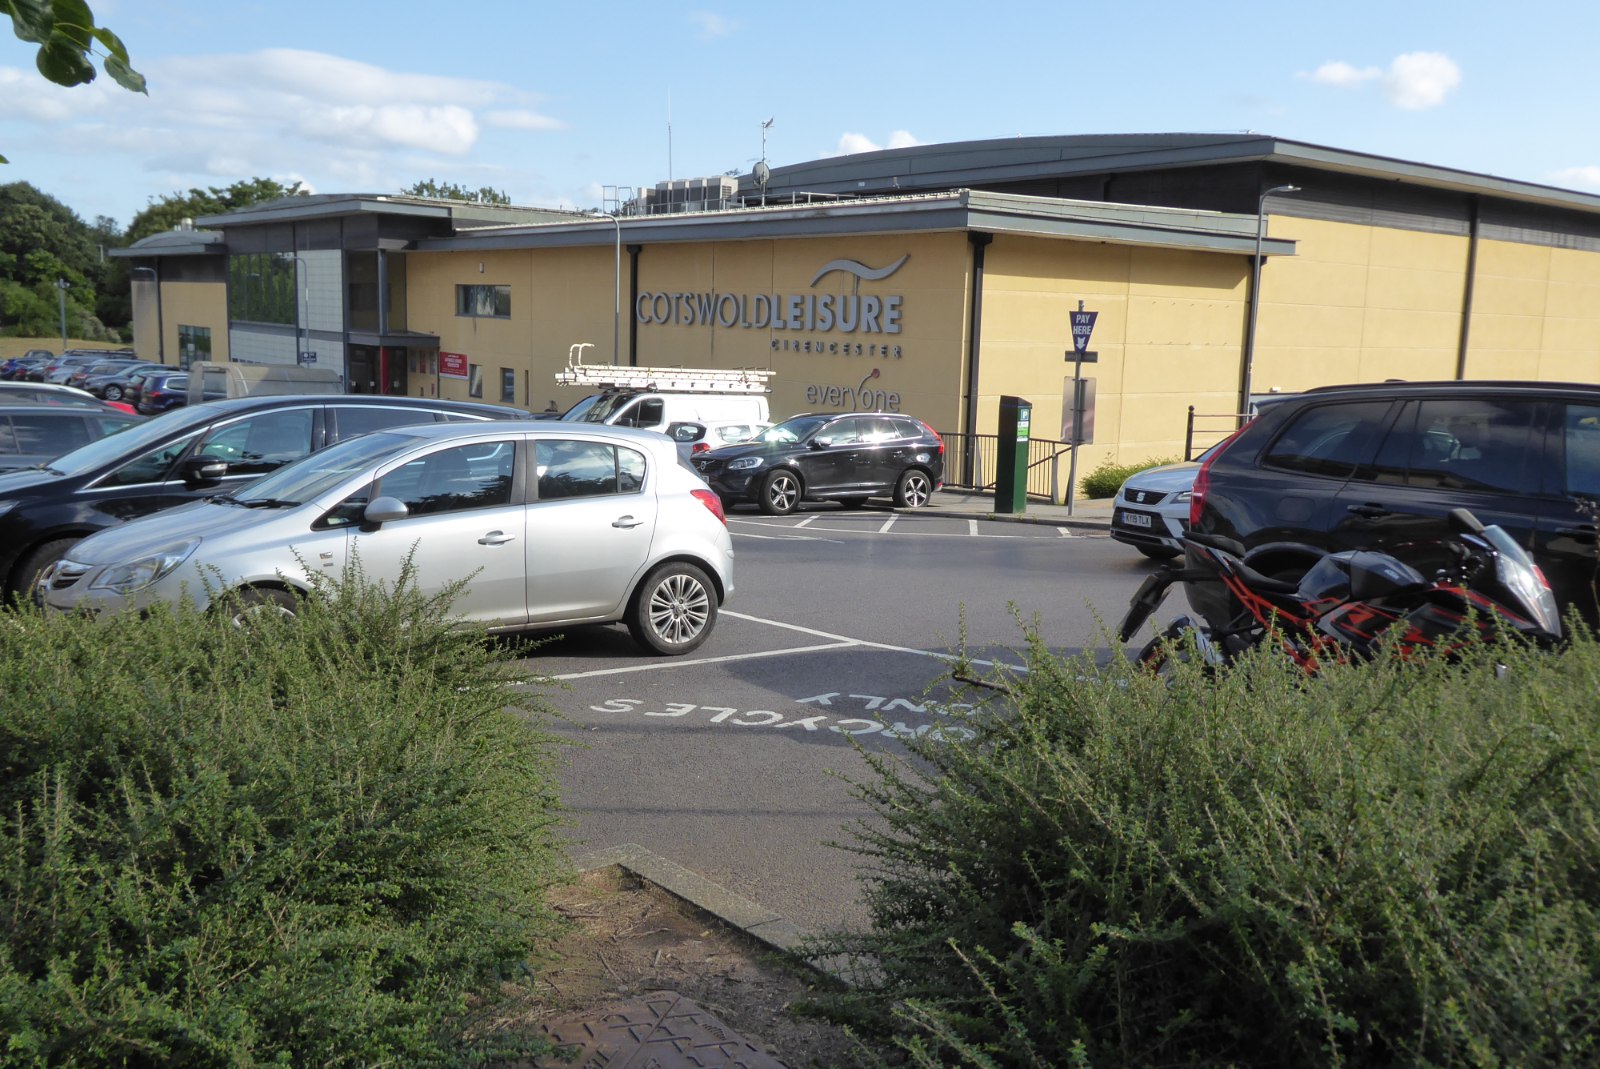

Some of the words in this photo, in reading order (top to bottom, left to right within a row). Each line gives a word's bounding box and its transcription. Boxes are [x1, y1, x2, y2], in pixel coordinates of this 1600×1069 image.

[1076, 314, 1090, 324] PAY
[1073, 325, 1092, 335] HERE
[770, 338, 902, 358] CIRENCESTER
[806, 367, 900, 412] everyone
[796, 692, 981, 716] ONLY
